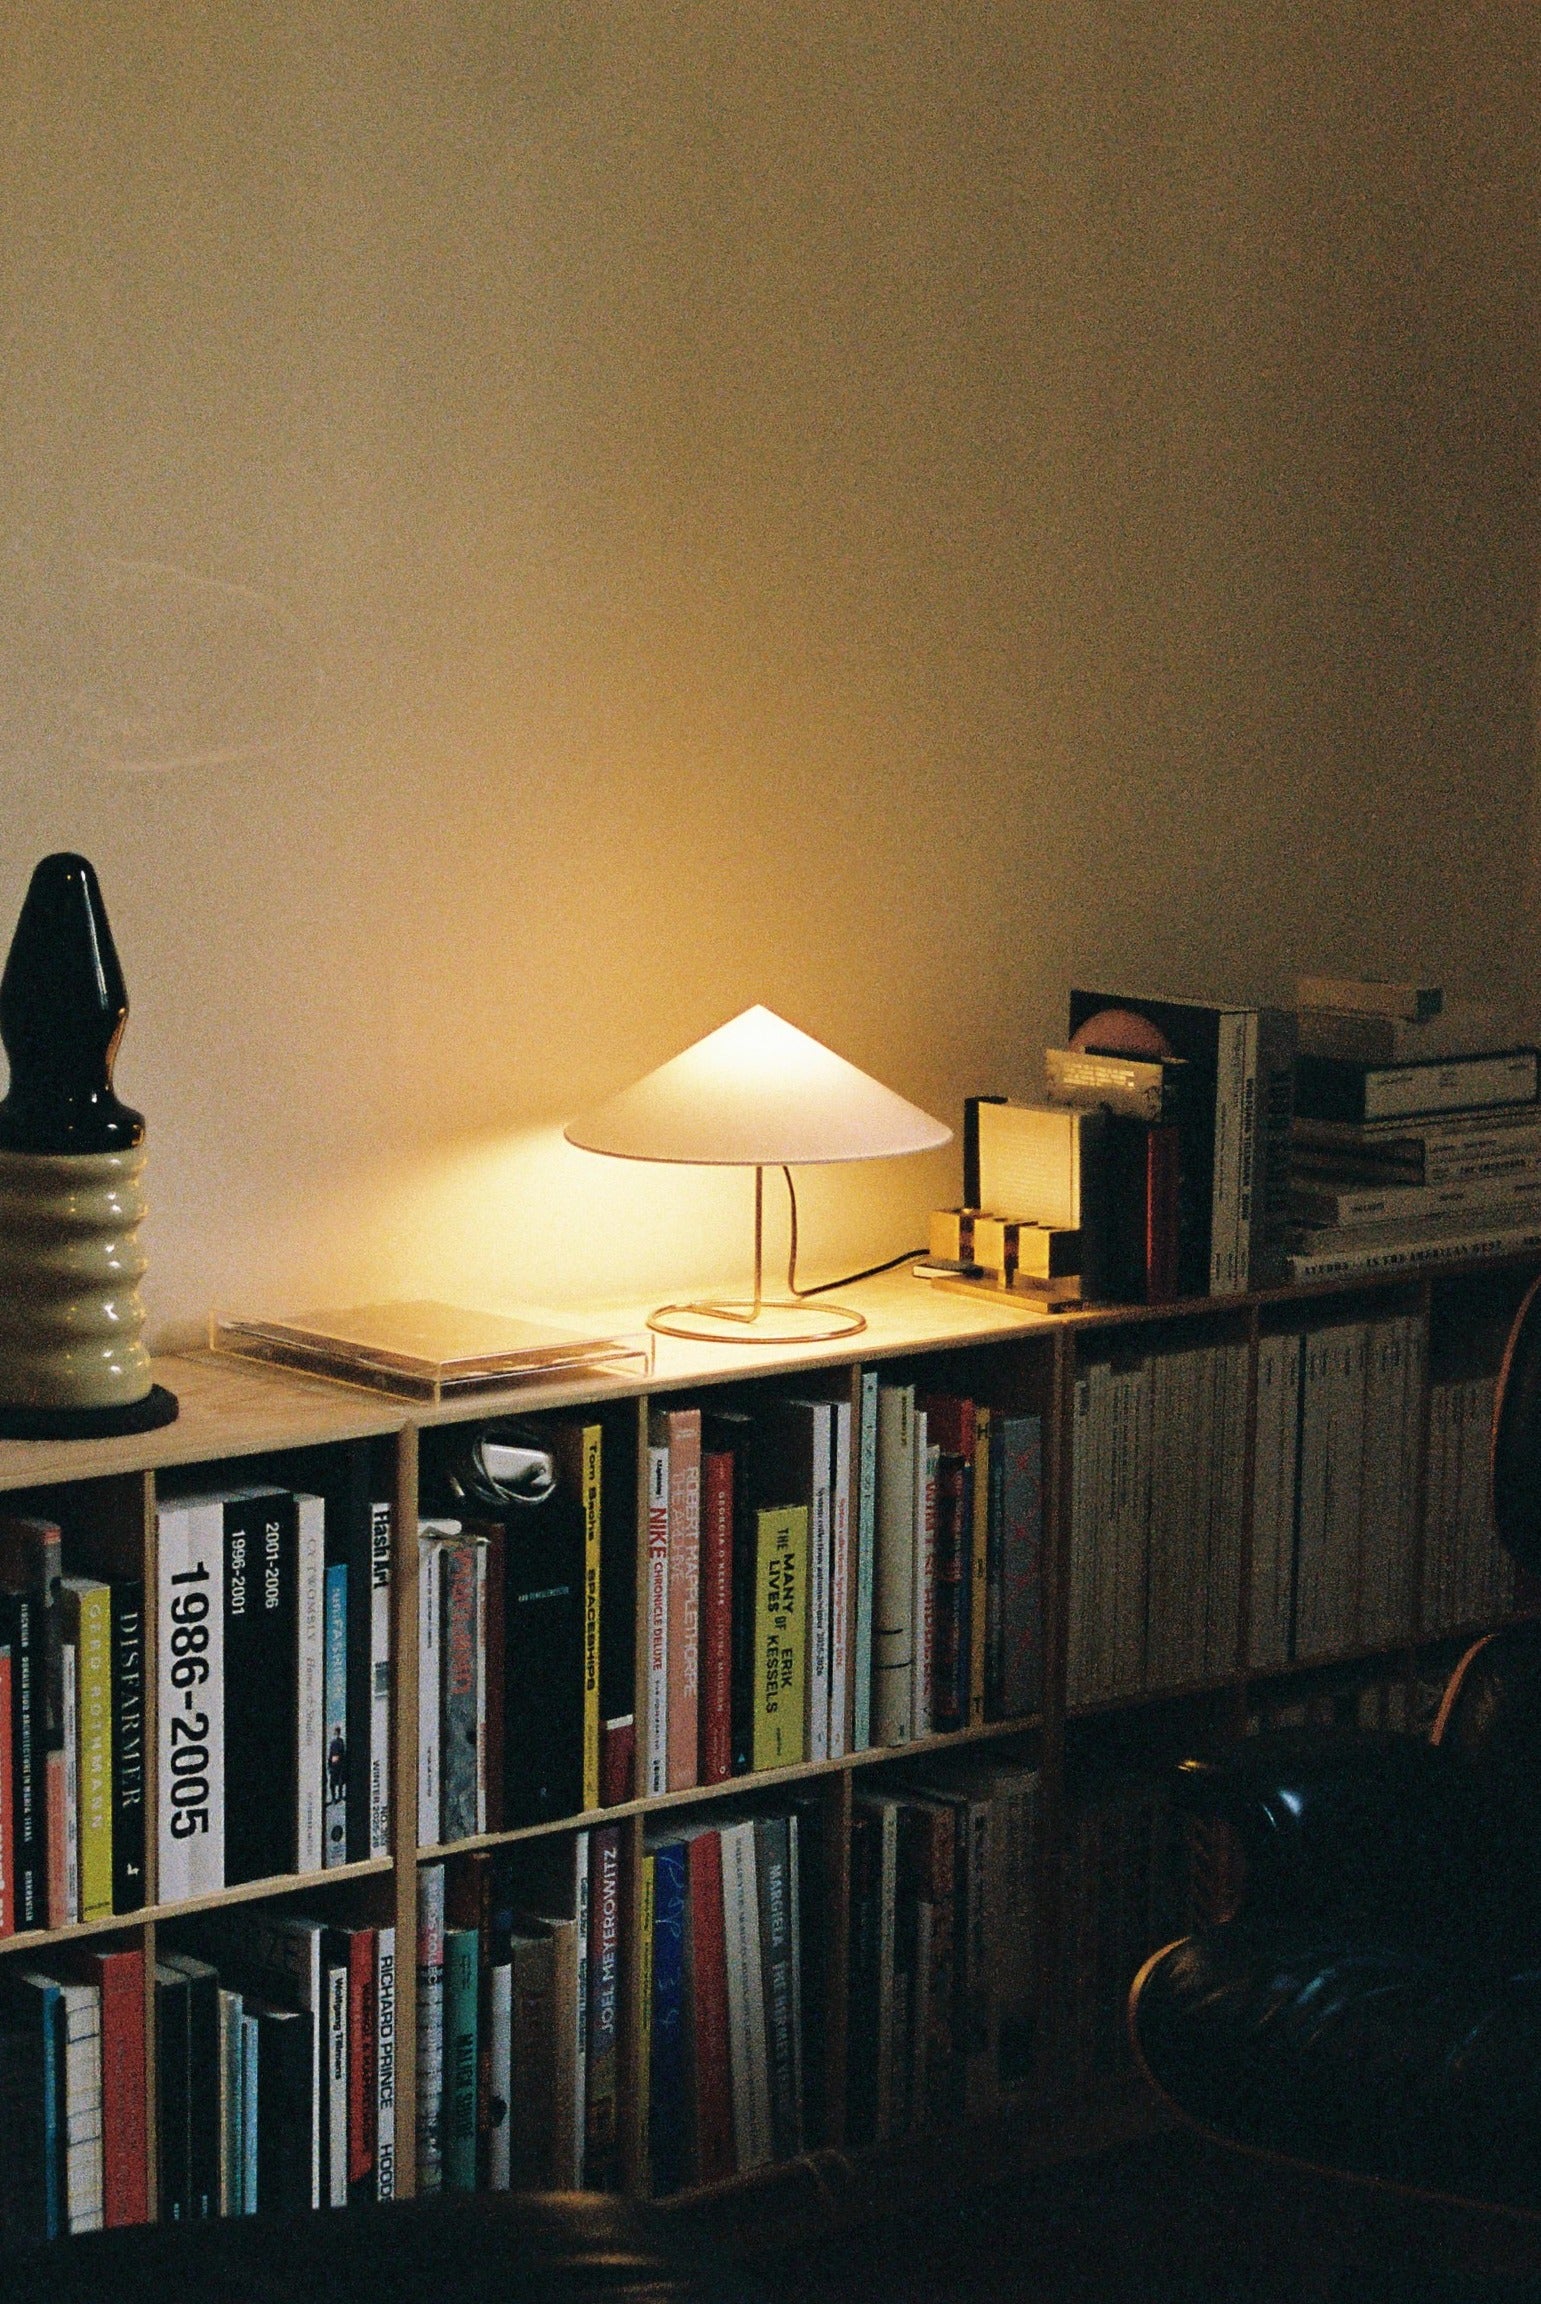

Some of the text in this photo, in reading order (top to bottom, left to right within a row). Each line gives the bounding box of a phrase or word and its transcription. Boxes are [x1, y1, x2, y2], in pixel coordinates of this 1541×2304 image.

[588, 1443, 598, 1480] Tom
[373, 1510, 391, 1589] Flash Art
[649, 1507, 667, 1559] NIKE
[717, 1491, 726, 1546] GEORGIA
[230, 1528, 247, 1615] 1996-2001
[264, 1521, 280, 1608] 2001-2006
[653, 1562, 664, 1626] CHRONICLE
[683, 1467, 699, 1697] ROBERT MAPPLETHORPE
[767, 1560, 787, 1630] LIVES OF
[777, 1527, 795, 1614] THE MANY
[586, 1568, 597, 1691] SPACESHIPS
[652, 1628, 663, 1671] DELUXE
[781, 1648, 794, 1689] ERIK
[118, 1609, 141, 1809] DISFARMER
[170, 1560, 210, 1840] 1986-2005
[765, 1635, 780, 1714] KESSELS
[372, 1759, 381, 1804] WINTER
[601, 1847, 617, 2034] JOEL MEYEROWITZ
[770, 1863, 785, 1948] MARGIELA
[333, 1977, 343, 2080] Wolfgang Tillmans
[380, 1955, 393, 2109] RICHARD PRINCE
